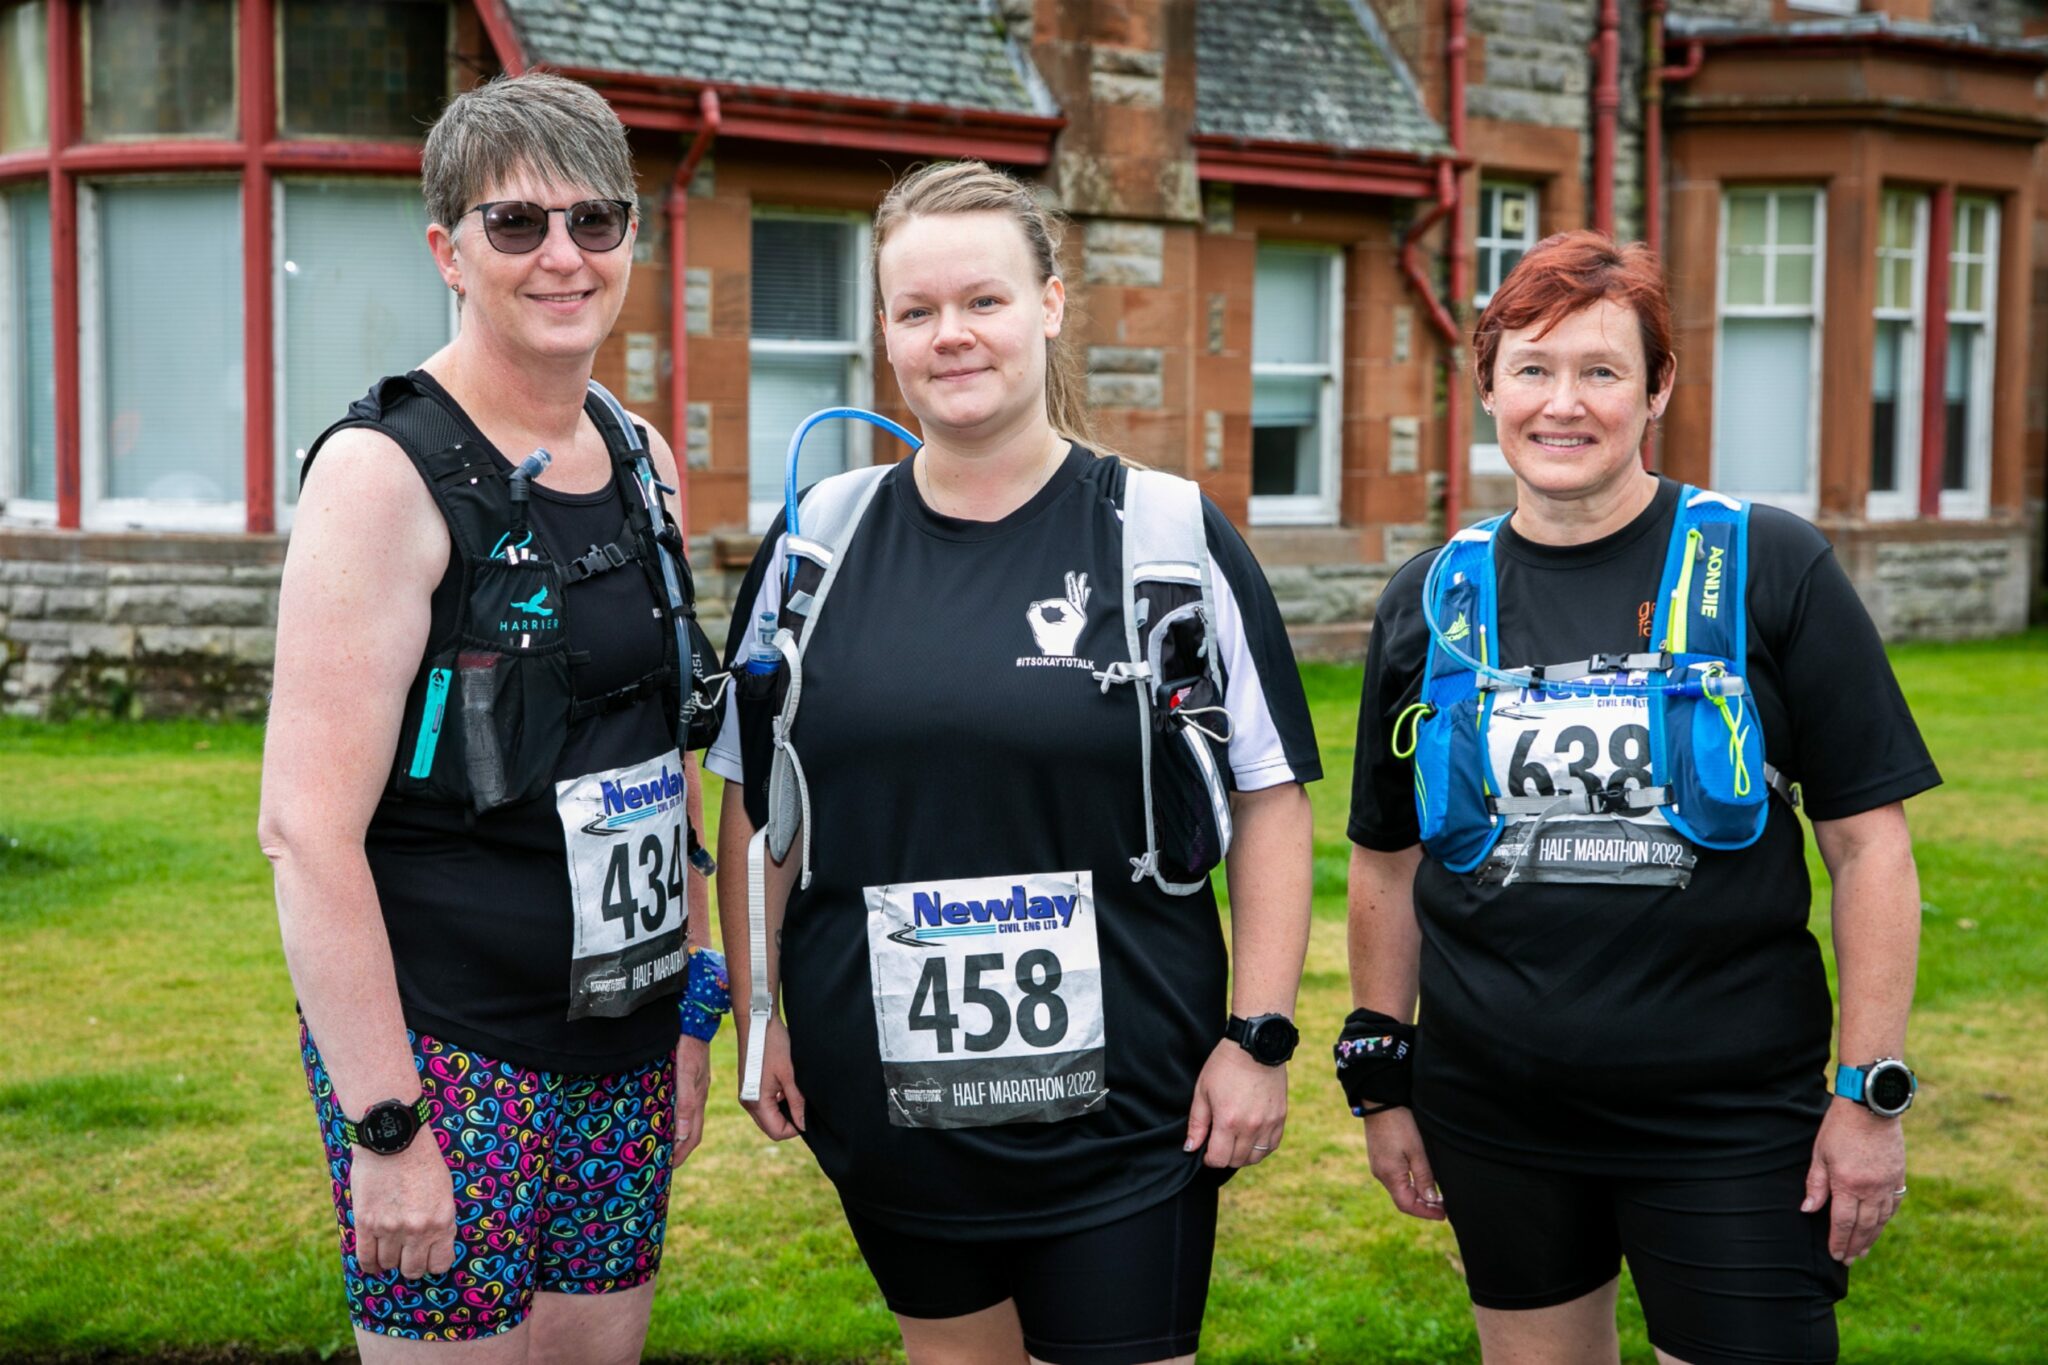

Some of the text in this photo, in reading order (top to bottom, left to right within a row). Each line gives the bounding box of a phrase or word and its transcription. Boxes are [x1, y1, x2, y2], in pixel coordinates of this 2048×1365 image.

[1701, 546, 1724, 619] AONIJIE
[500, 619, 560, 632] HARRIER
[1016, 657, 1095, 671] #ITSOKAYTOTALK
[1597, 699, 1618, 708] CIVIL
[1638, 698, 1649, 708] LT
[1507, 723, 1652, 818] 638
[1539, 838, 1573, 862] HALF
[1574, 839, 1648, 863] MARATHON
[1651, 842, 1684, 866] 2022
[601, 824, 684, 940] 434
[913, 885, 1078, 928] Newlay
[998, 919, 1058, 934] CIVIL ENG LTD
[633, 961, 653, 990] HALF
[908, 948, 1069, 1054] 458
[953, 1081, 986, 1107] HALF
[989, 1075, 1065, 1105] MARATHON
[1066, 1070, 1097, 1098] 2022
